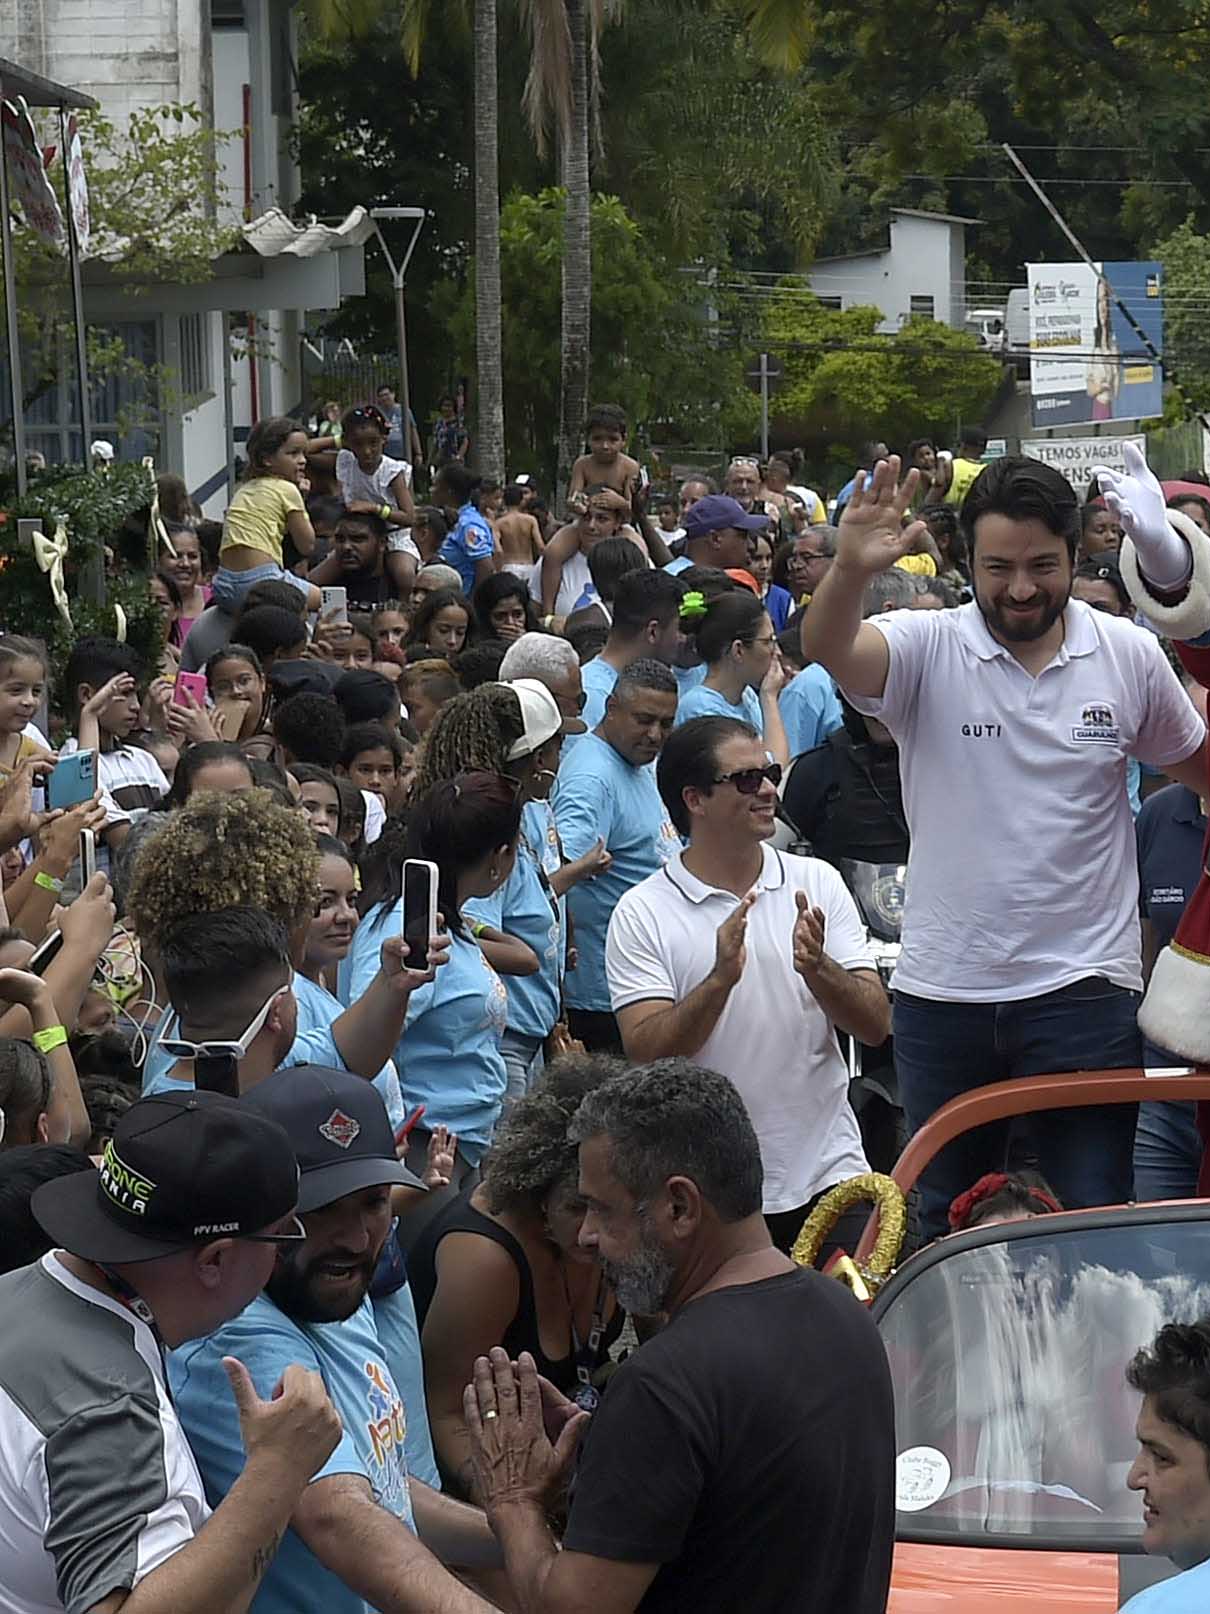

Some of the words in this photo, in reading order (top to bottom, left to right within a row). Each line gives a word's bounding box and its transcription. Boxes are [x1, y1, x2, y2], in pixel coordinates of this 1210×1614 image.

[1038, 447, 1080, 461] TEMOS
[1084, 445, 1119, 459] VAGAS
[961, 724, 1001, 738] GUTI
[194, 1225, 211, 1236] FPV
[212, 1221, 239, 1233] RACER
